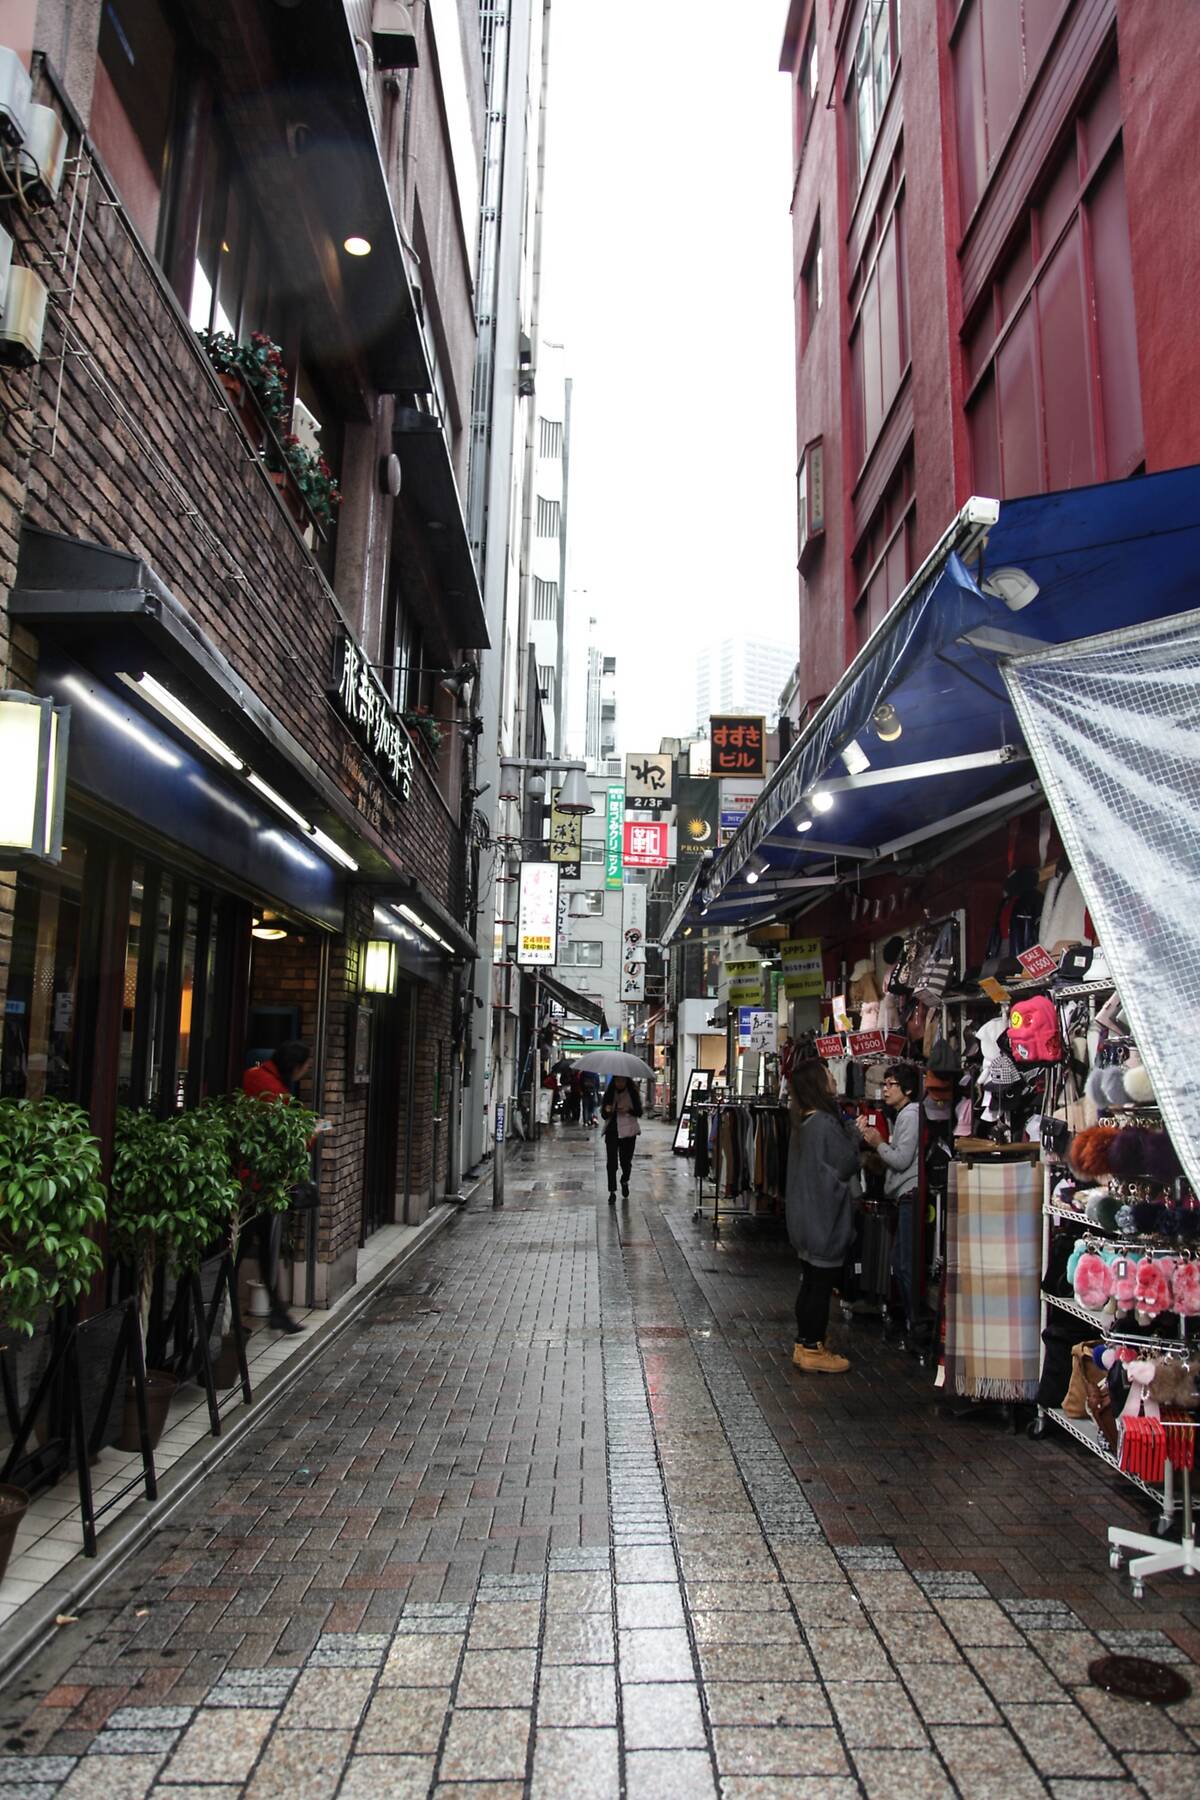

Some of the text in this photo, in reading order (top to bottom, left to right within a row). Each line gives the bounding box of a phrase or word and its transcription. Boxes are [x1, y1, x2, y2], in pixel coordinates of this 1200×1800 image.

[713, 725, 761, 748] すずき
[719, 752, 756, 768] ビル
[1024, 949, 1041, 962] SALE
[853, 1040, 881, 1051] ¥1500
